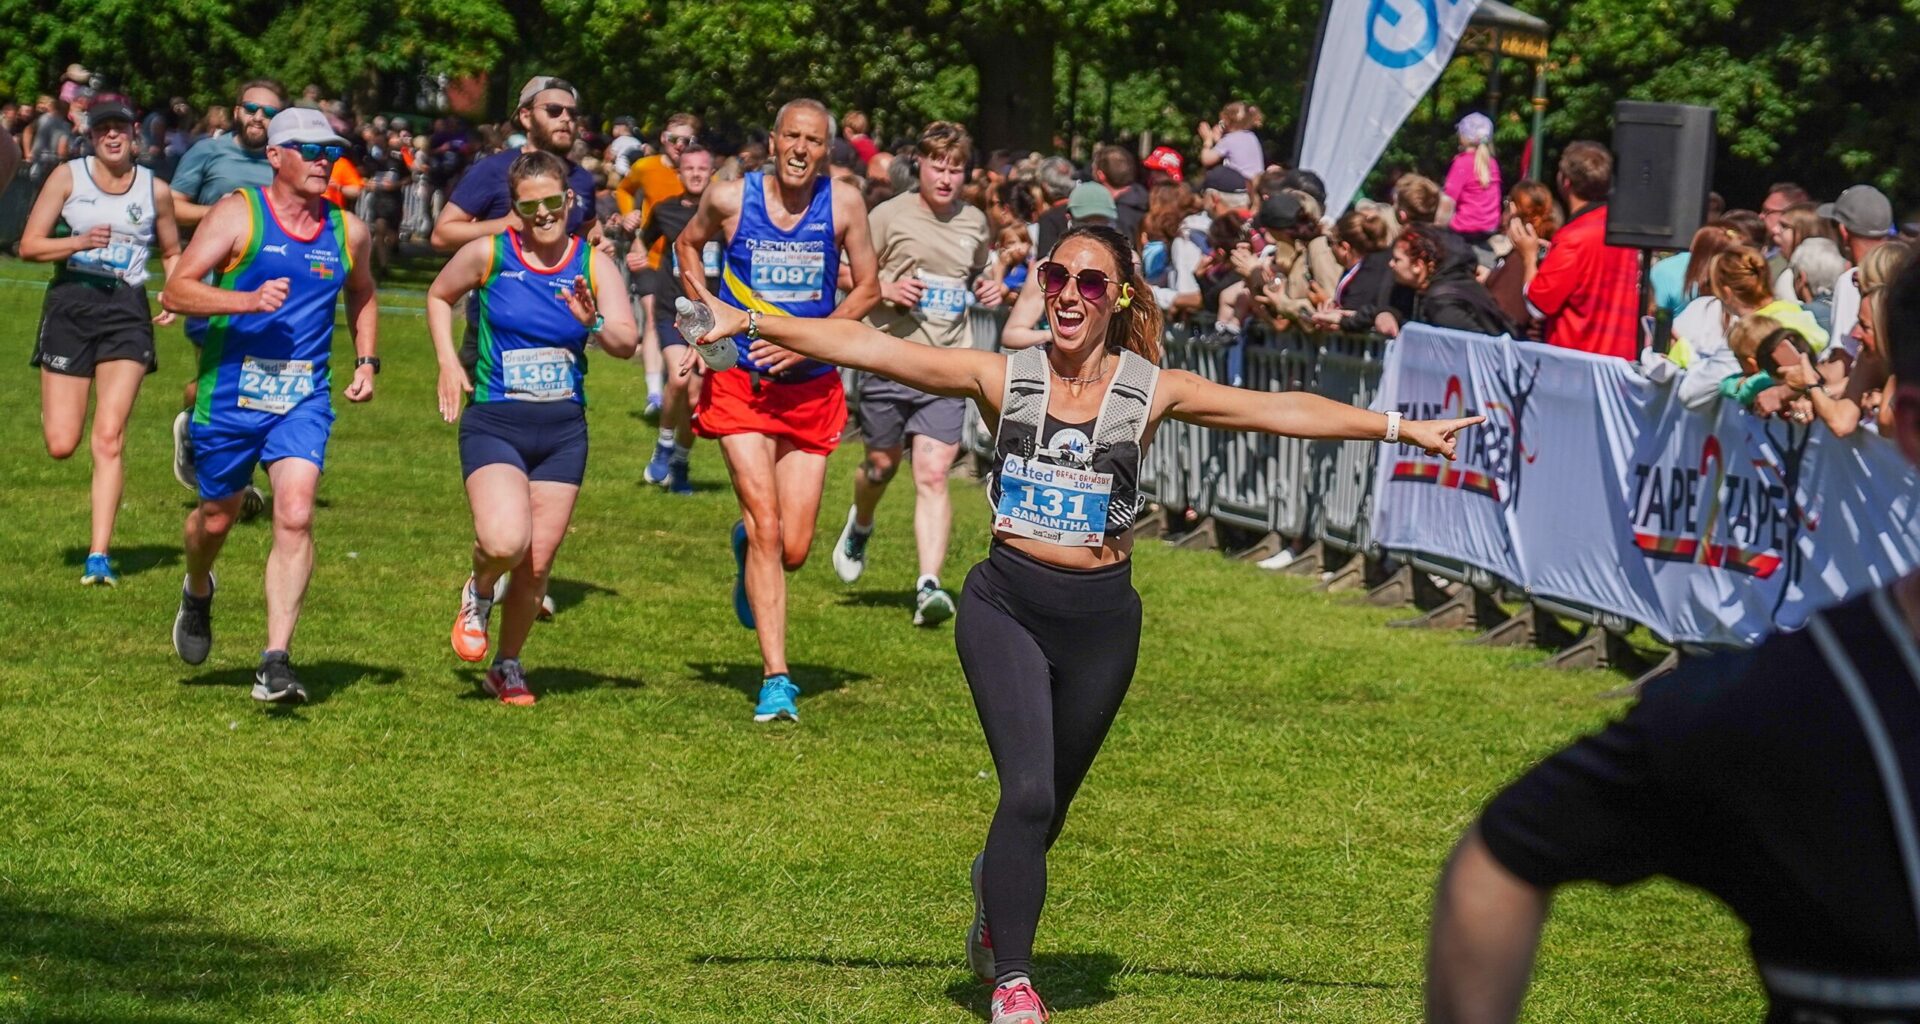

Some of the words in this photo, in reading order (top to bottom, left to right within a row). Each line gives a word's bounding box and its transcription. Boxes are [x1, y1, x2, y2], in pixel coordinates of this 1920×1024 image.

[756, 266, 820, 285] 1097
[243, 373, 309, 396] 2474
[509, 363, 569, 384] 1367
[1073, 481, 1093, 490] 10K
[1020, 485, 1088, 520] 131
[1011, 507, 1091, 532] SAMANTHA
